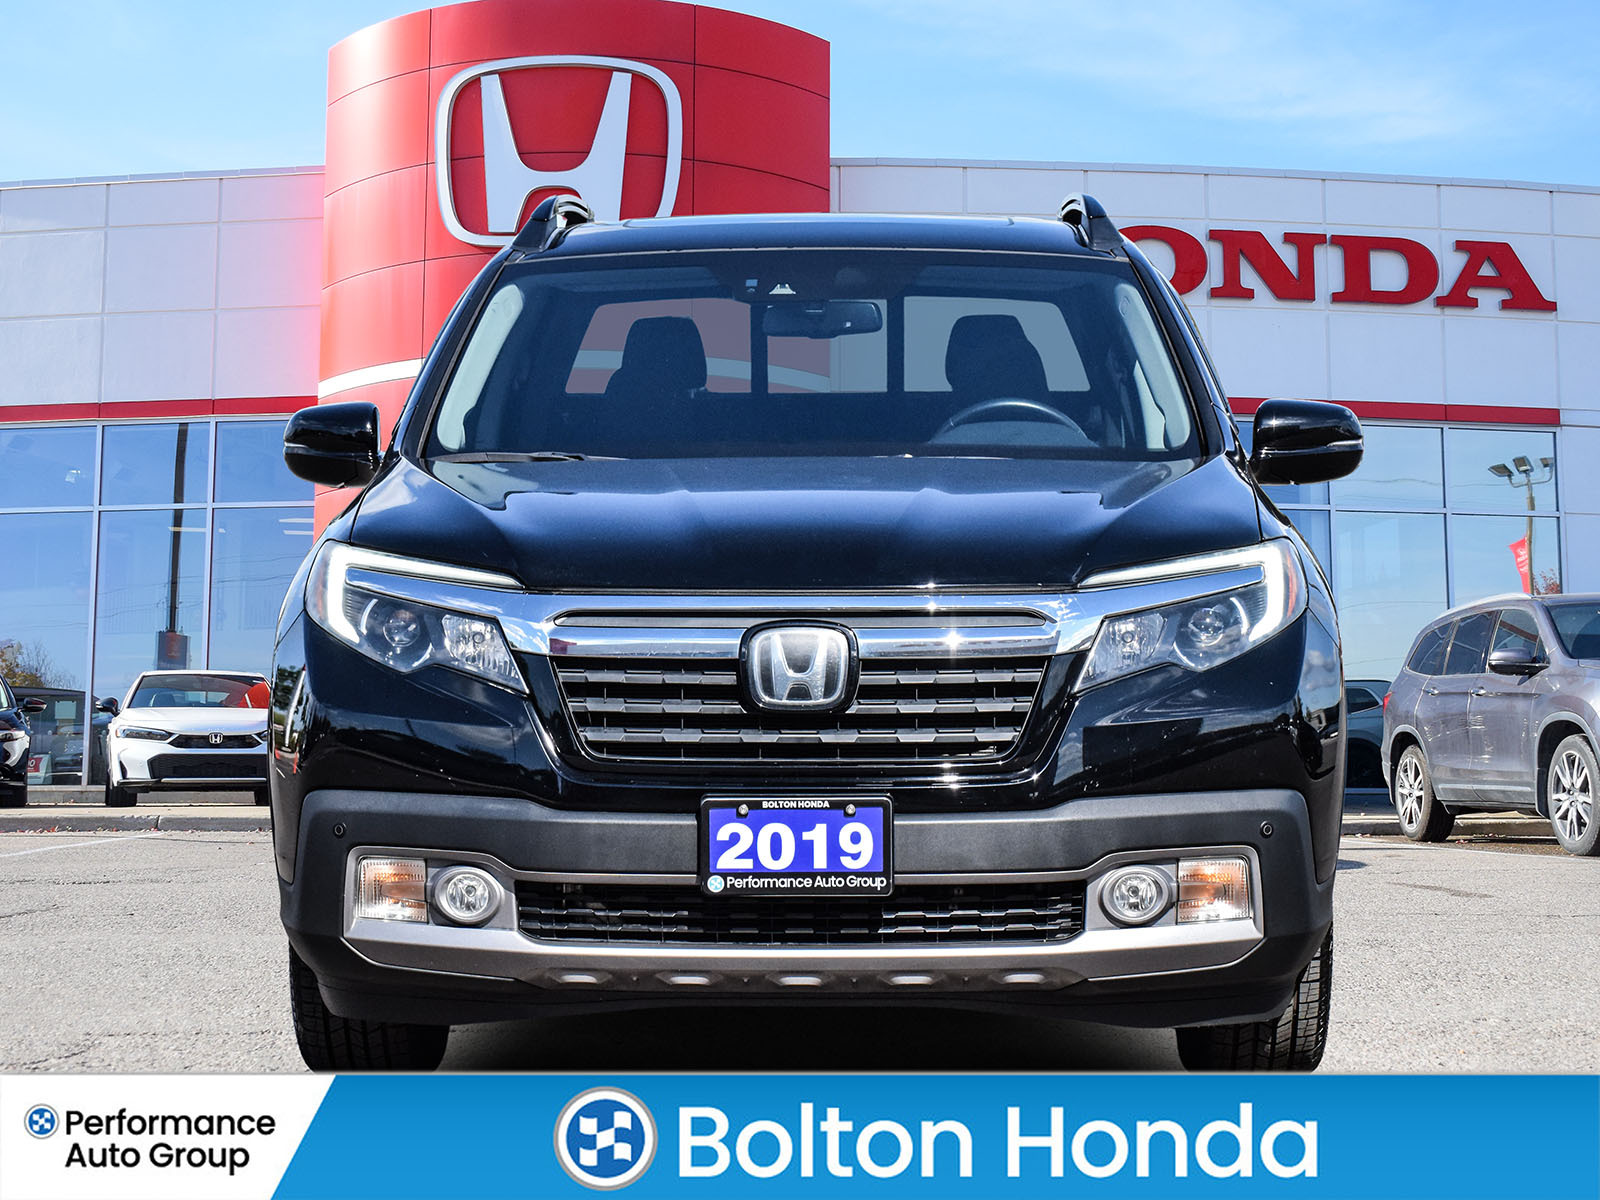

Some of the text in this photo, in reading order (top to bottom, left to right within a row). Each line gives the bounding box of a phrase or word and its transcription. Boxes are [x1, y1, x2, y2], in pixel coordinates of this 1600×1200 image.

[1118, 225, 1557, 312] ONDA
[762, 800, 830, 809] BOLTON HONDA
[716, 822, 874, 870] 2019
[727, 875, 887, 891] Performance Auto Group
